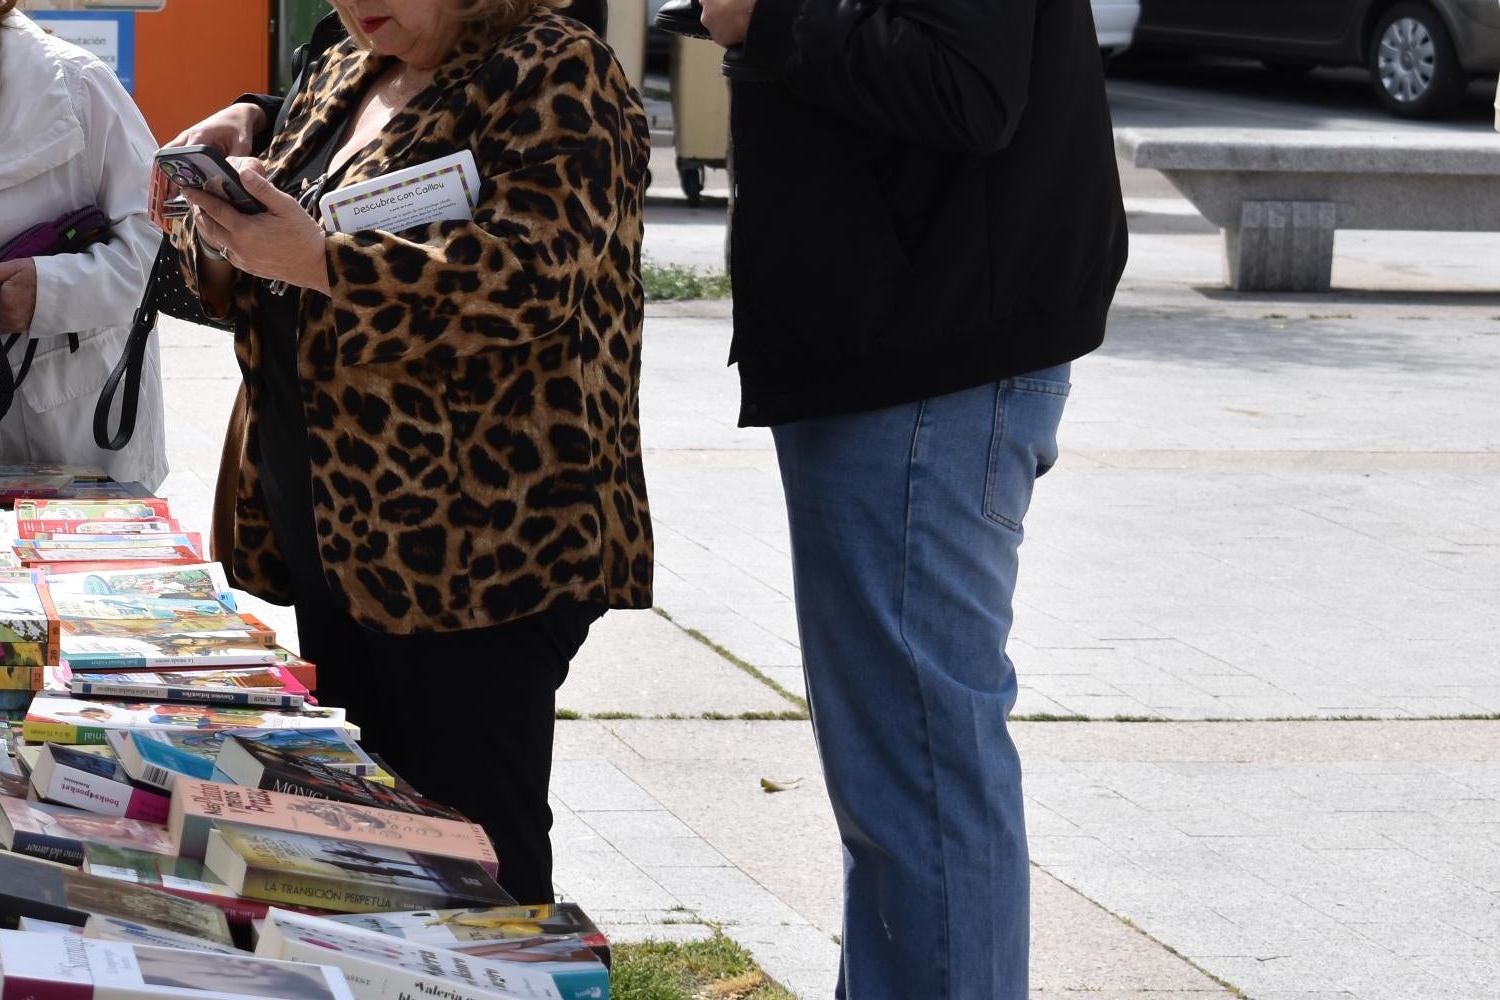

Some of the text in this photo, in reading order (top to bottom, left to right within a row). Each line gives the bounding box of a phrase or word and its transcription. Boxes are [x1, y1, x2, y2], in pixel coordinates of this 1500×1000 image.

[353, 195, 397, 215] Descubre
[397, 191, 415, 201] con
[415, 182, 446, 195] Caillou
[181, 690, 209, 699] Infantiles
[210, 692, 234, 700] Cuentos
[61, 783, 120, 807] books4pocket
[264, 879, 277, 892] LA
[282, 883, 342, 901] TRANSICIÓN
[345, 892, 392, 909] PERPETUA
